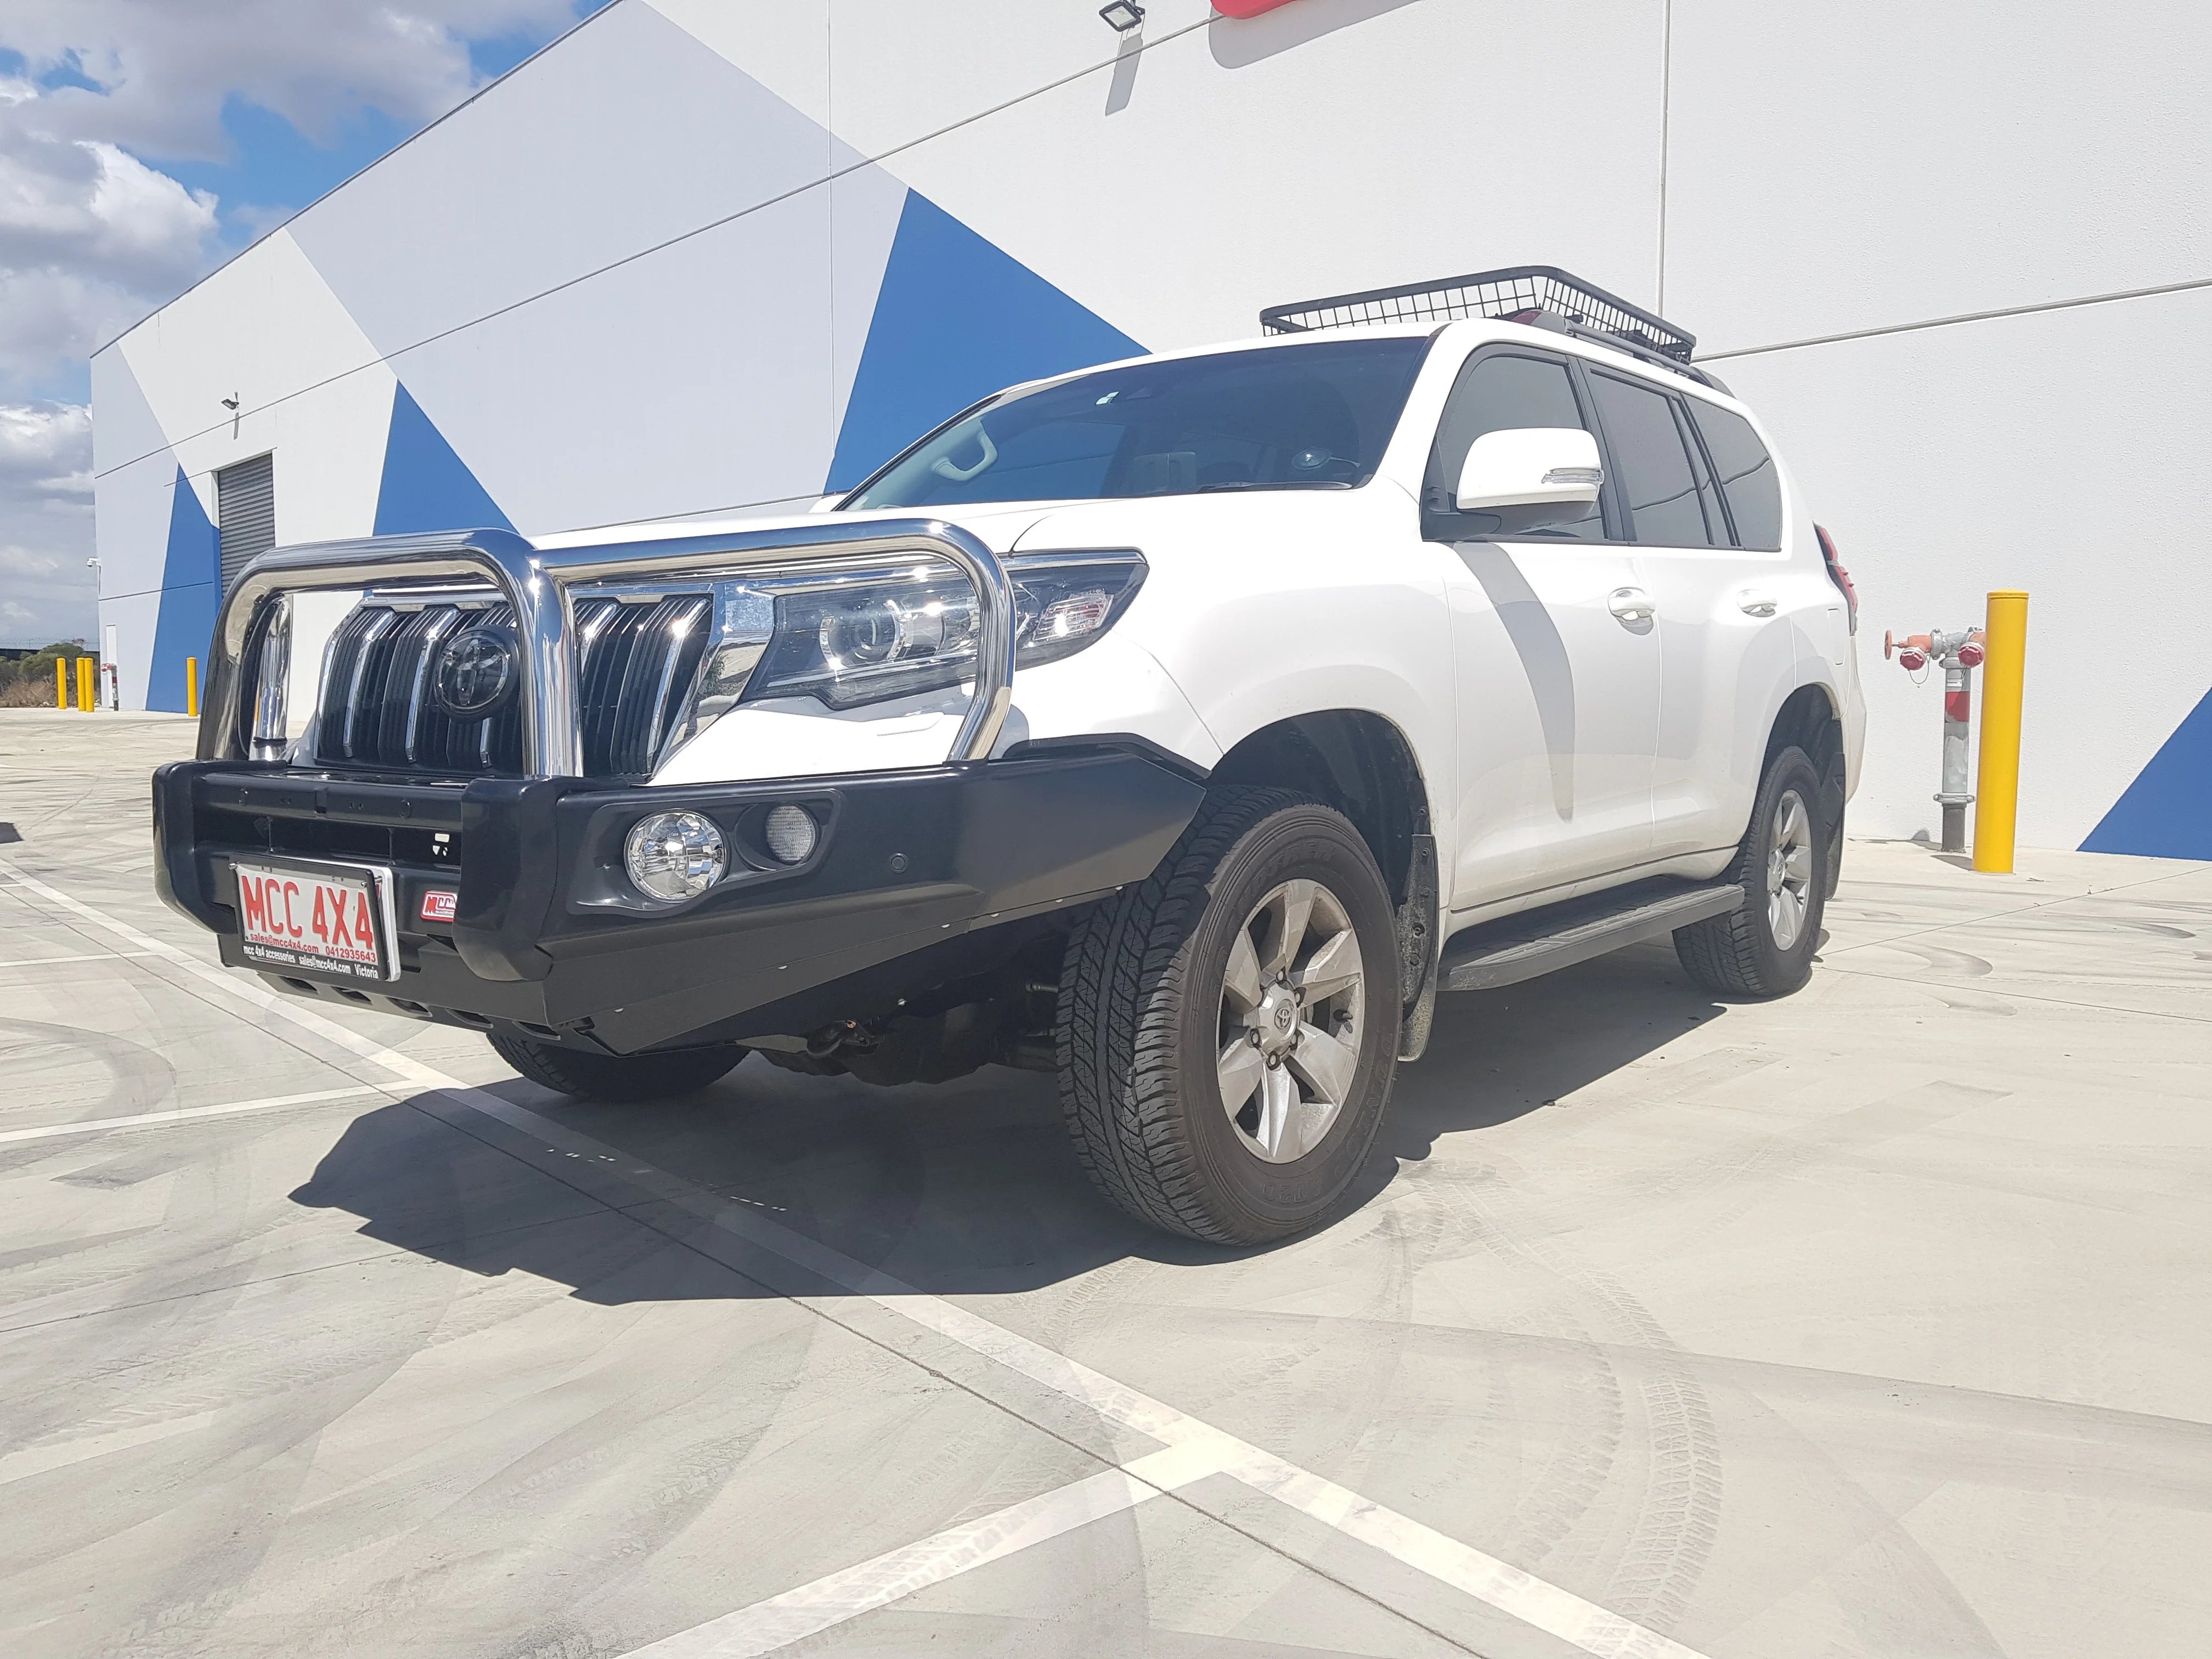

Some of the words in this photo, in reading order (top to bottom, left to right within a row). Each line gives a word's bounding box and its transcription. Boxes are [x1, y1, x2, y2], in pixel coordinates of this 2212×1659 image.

[241, 876, 302, 938] MCC
[312, 885, 373, 950] 4X4
[243, 945, 255, 955] mcc
[255, 946, 265, 957] 4x4
[266, 950, 296, 963] accessories
[298, 956, 351, 974] sales@mcc4x4.com
[354, 964, 379, 979] Victoria
[250, 933, 319, 953] sales@mcc4x4.com
[325, 945, 376, 963] 0412935643
